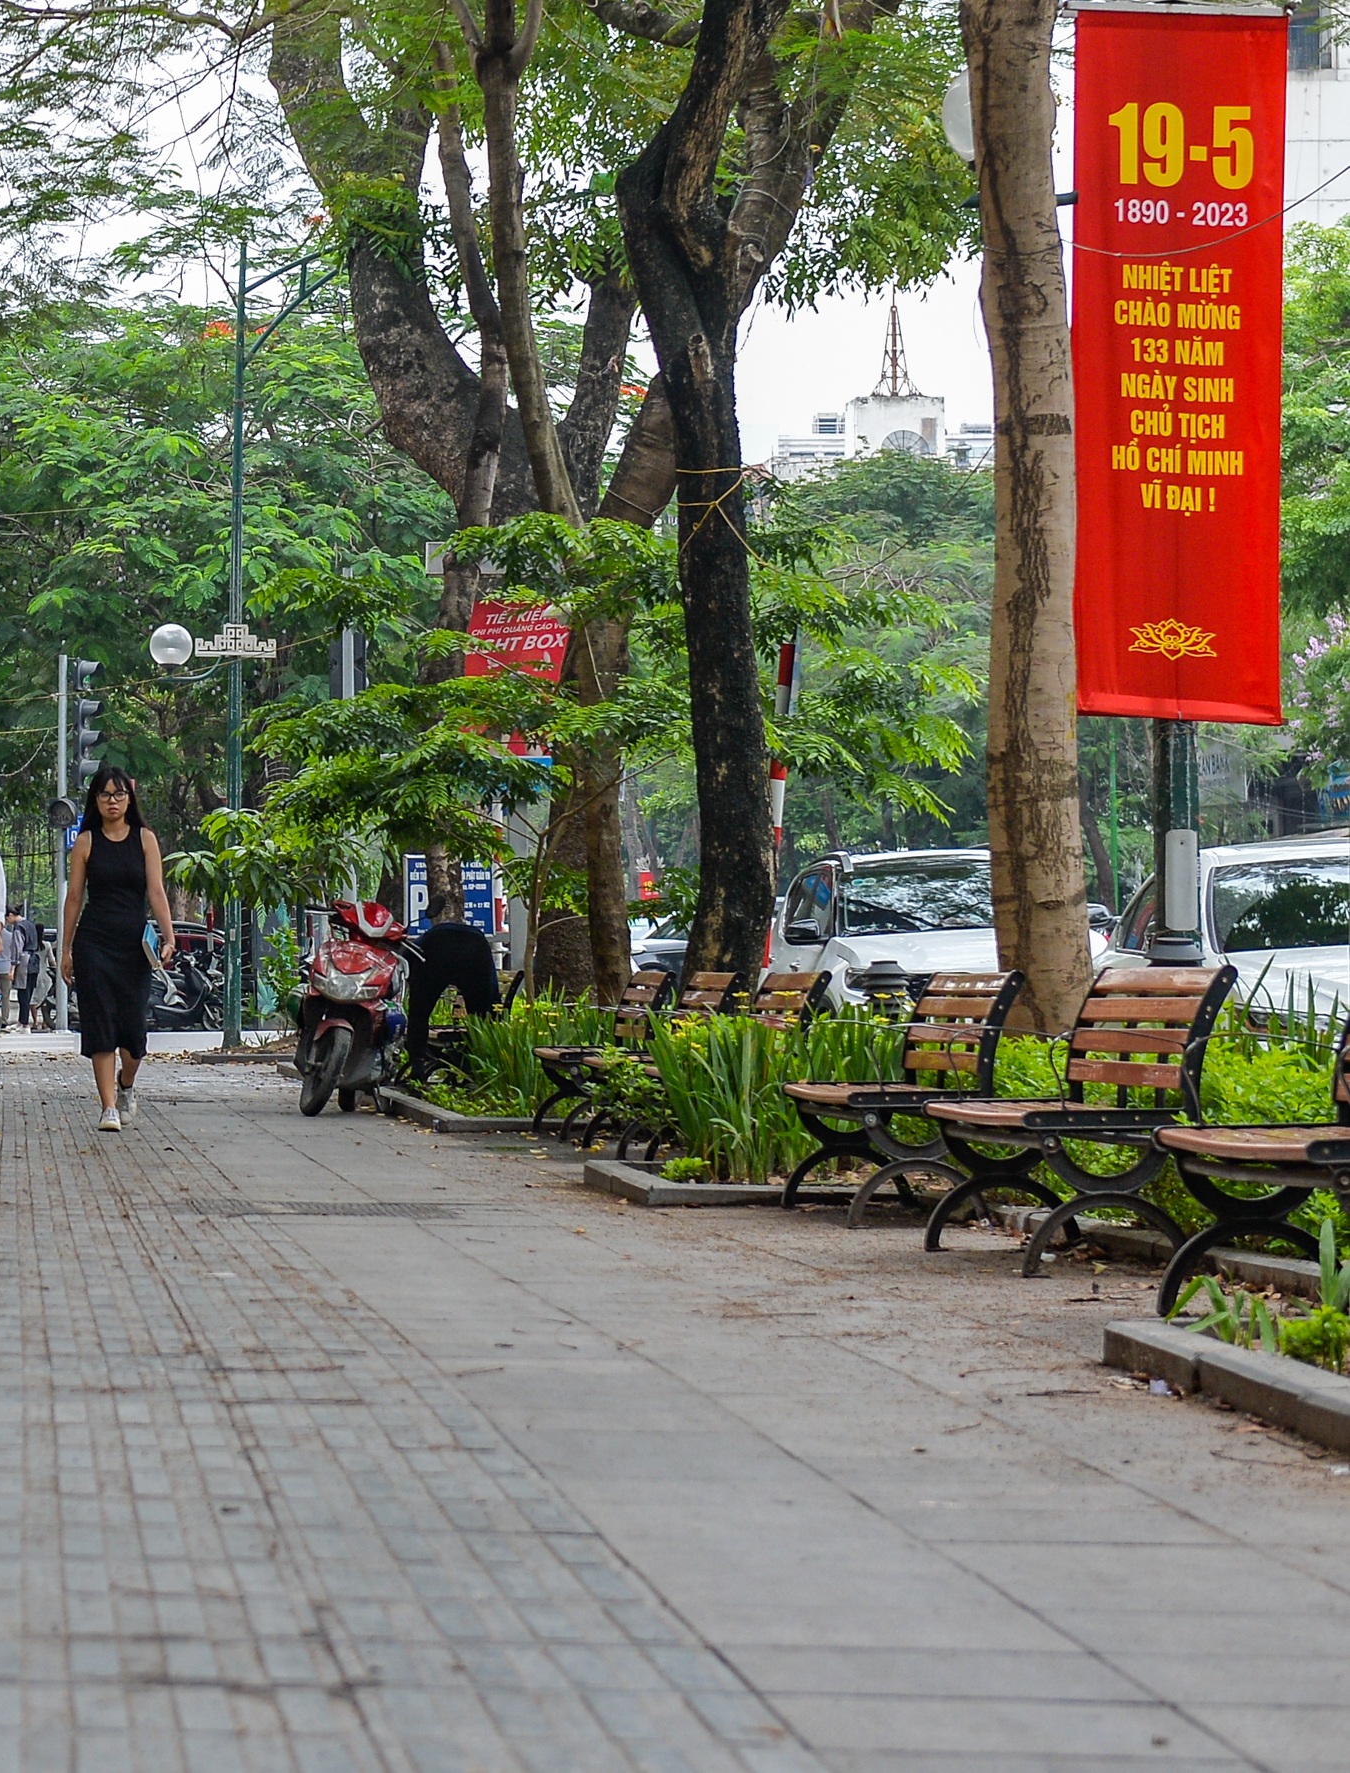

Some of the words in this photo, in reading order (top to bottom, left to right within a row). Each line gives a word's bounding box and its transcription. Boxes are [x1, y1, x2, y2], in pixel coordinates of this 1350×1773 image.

[1108, 102, 1255, 190] 19-5
[1114, 199, 1170, 225] 1890
[1192, 202, 1249, 227] 2023
[1122, 261, 1184, 296] NHIỆT
[1189, 263, 1233, 299] LIỆT
[1114, 297, 1171, 328] CHÀO
[1177, 300, 1241, 330] MỪNG
[1131, 337, 1169, 364] 133
[1174, 336, 1224, 366] NĂM
[1121, 370, 1177, 401] NGÀY
[1183, 377, 1234, 402] SINH
[1130, 404, 1172, 437] CHỦ
[1178, 413, 1225, 444] TỊCH
[1111, 438, 1141, 471] HỒ
[1146, 443, 1181, 474] CHÍ
[1187, 450, 1243, 476] MINH
[1140, 480, 1161, 509] VĨ
[1166, 486, 1202, 516] ĐẠI
[471, 628, 487, 636] CHI
[522, 632, 570, 651] BOX
